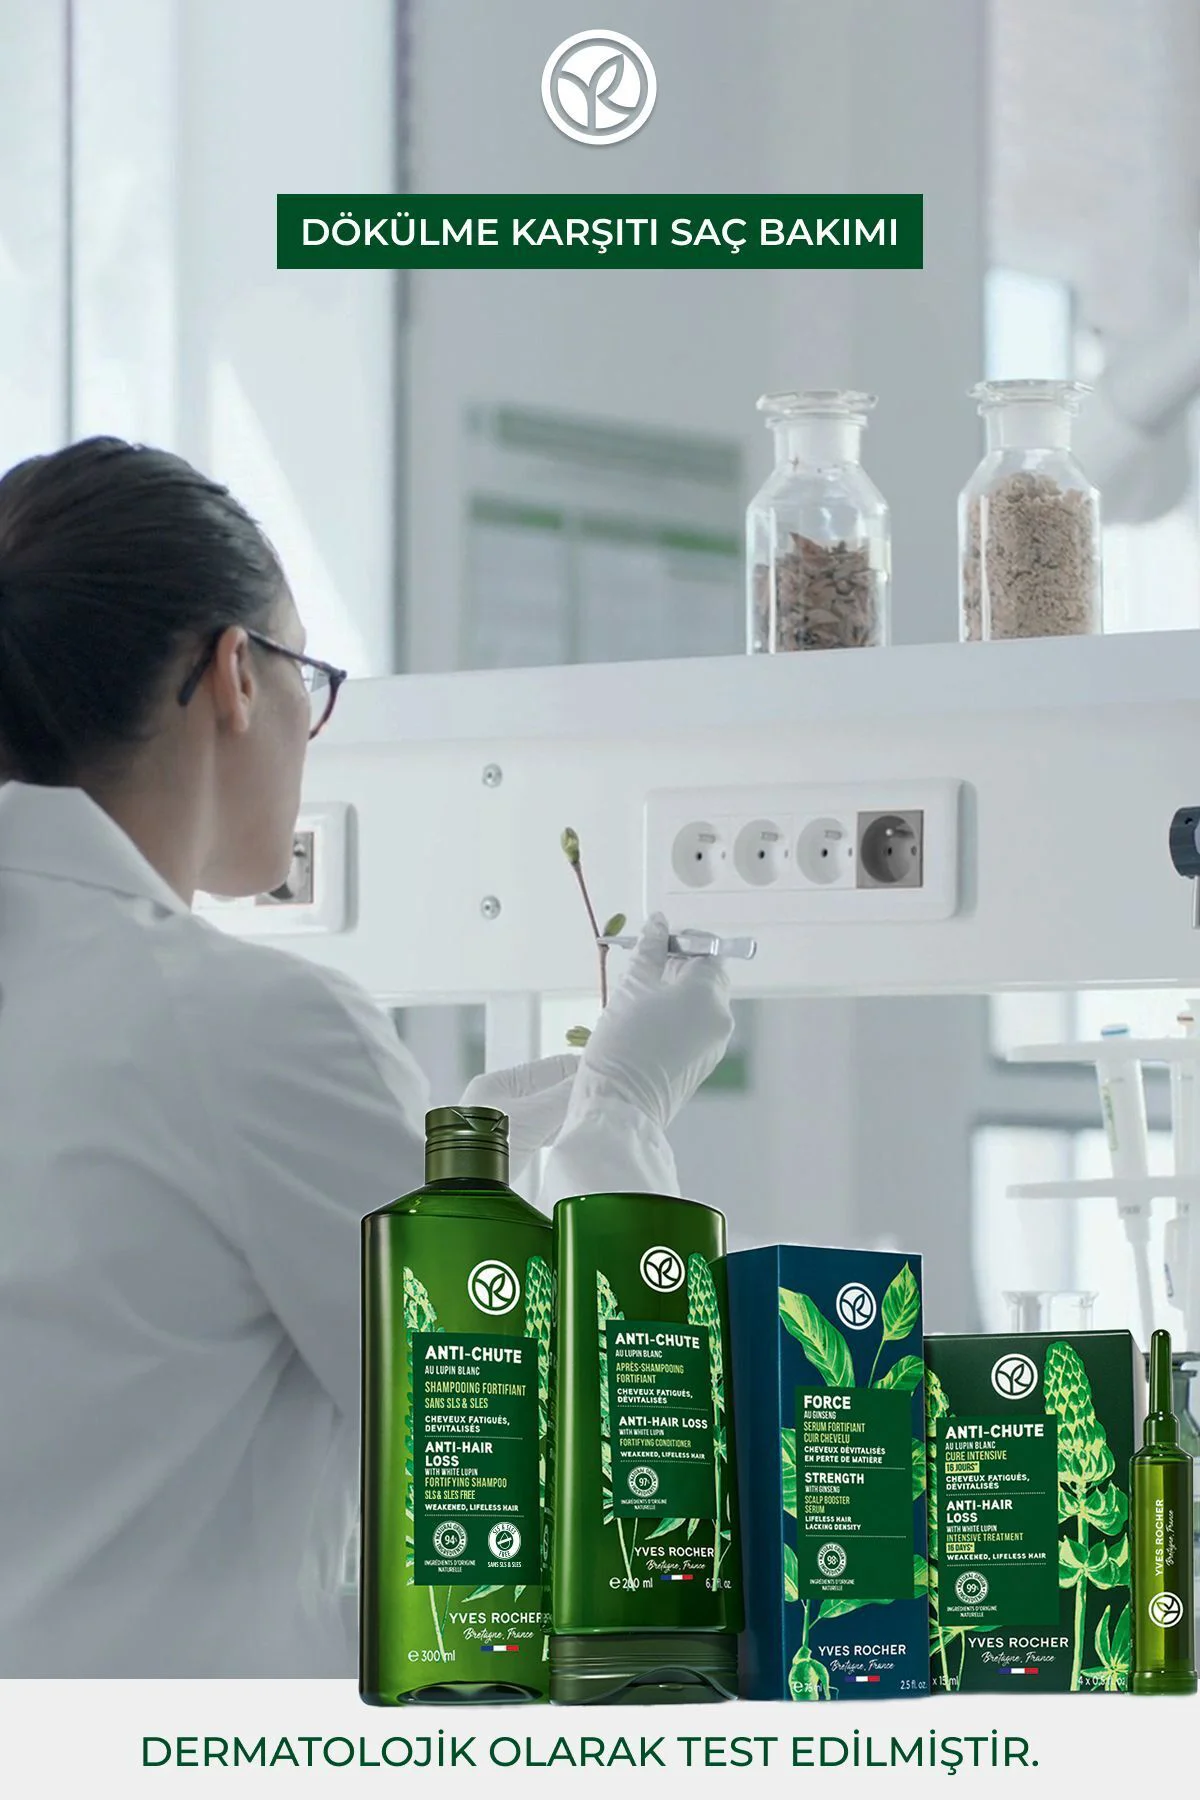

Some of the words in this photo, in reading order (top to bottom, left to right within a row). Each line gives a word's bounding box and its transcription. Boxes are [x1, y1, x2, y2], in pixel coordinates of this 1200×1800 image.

[615, 1332, 700, 1349] ANTI-CHUTE
[425, 1345, 522, 1364] ANTI-CHUTE
[624, 1350, 643, 1358] LUPIN
[643, 1350, 662, 1358] BLANC
[425, 1366, 435, 1375] AU
[436, 1366, 456, 1375] LUPIN
[458, 1366, 480, 1376] BLANC
[617, 1374, 656, 1383] FORTIFIANT
[425, 1382, 480, 1394] SHAMPOOING
[483, 1383, 527, 1397] FORTIFIANT
[617, 1388, 655, 1396] CHEVEUX
[656, 1387, 693, 1398] FATIGUÉS,
[425, 1398, 444, 1409] SANS
[469, 1398, 489, 1409] SLES
[804, 1395, 851, 1409] FORCE
[468, 1415, 510, 1426] FATIGUÉS,
[812, 1411, 836, 1419] GINSENG
[619, 1416, 679, 1427] ANTI-HAIR
[682, 1418, 708, 1429] LOSS
[828, 1422, 865, 1432] FORTIFIANT
[945, 1424, 1044, 1439] ANTI-CHUTE
[619, 1439, 654, 1447] FORTIFYING
[656, 1439, 691, 1448] CONDITIONER
[804, 1433, 819, 1443] CUIR
[820, 1433, 850, 1443] CHEVELU
[425, 1442, 494, 1453] ANTI-HAIR
[804, 1446, 838, 1454] CHEVEUX
[841, 1445, 886, 1455] DÉVITALISÉS
[945, 1442, 954, 1450] AU
[955, 1442, 973, 1450] LUPIN
[425, 1455, 459, 1467] LOSS
[946, 1451, 966, 1461] CURE
[967, 1450, 1007, 1460] INTENSIVE
[425, 1468, 440, 1476] WITH
[441, 1468, 459, 1476] WHITE
[988, 1473, 1030, 1482] FATIGUÉS,
[425, 1477, 470, 1487] FORTIFYING
[472, 1478, 507, 1488] SHAMPOO
[805, 1472, 865, 1484] STRENGTH
[443, 1491, 459, 1500] SLES
[460, 1491, 476, 1500] FREE
[805, 1496, 824, 1504] SCALP
[824, 1496, 850, 1505] BOOSTER
[425, 1503, 468, 1512] WEAKENED,
[503, 1504, 519, 1512] HAIR
[805, 1505, 825, 1513] SERUM
[946, 1500, 1013, 1511] ANTI-HAIR
[946, 1513, 978, 1523] LOSS
[1156, 1499, 1164, 1545] ROCHER
[946, 1533, 982, 1541] INTENSIVE
[983, 1533, 1024, 1541] TREATMENT
[634, 1547, 665, 1556] YVES
[669, 1547, 714, 1557] ROCHER
[1156, 1549, 1164, 1576] YVES
[643, 1578, 653, 1588] ml
[449, 1612, 486, 1623] YVES
[968, 1637, 1004, 1648] YVES
[1009, 1637, 1069, 1647] ROCHER
[818, 1645, 850, 1656] YVES
[854, 1644, 906, 1655] ROCHER
[421, 1650, 440, 1662] 300
